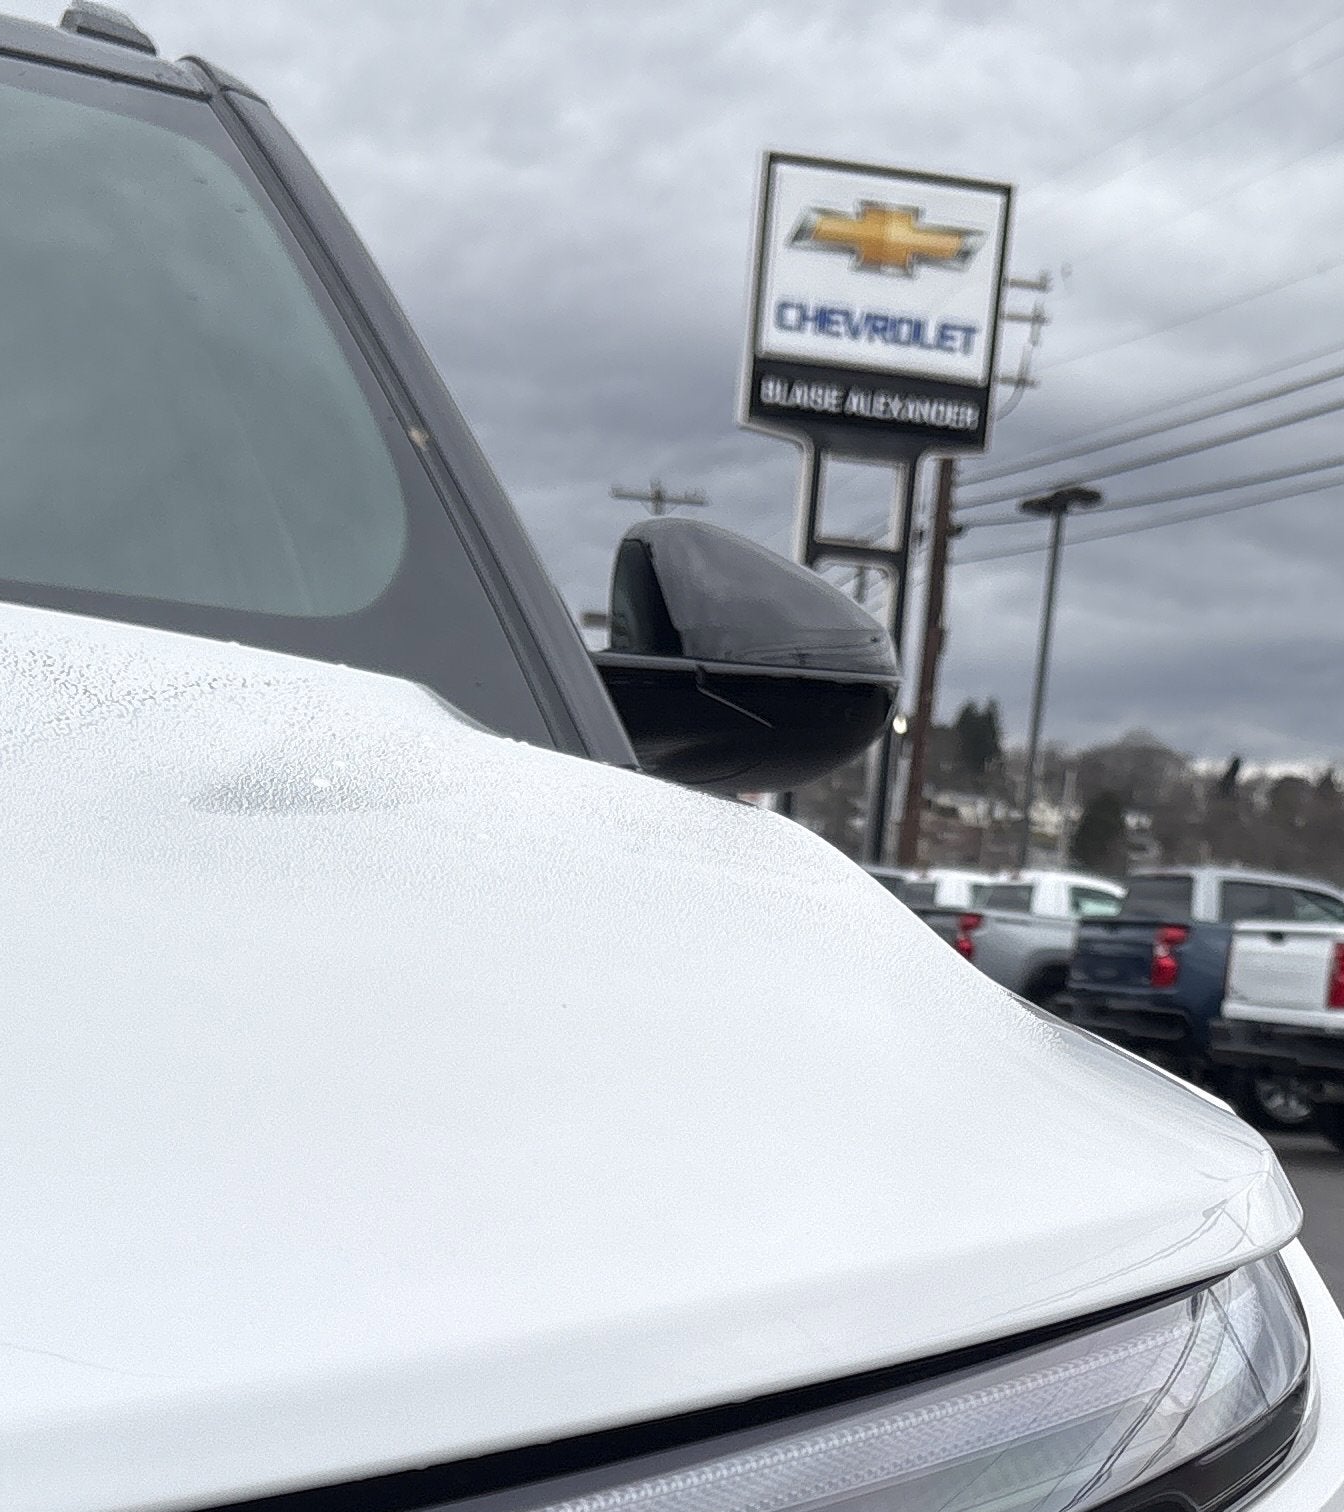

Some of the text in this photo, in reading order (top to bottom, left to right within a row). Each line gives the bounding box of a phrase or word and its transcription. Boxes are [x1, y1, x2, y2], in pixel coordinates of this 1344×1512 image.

[776, 301, 976, 353] CHEVROLET
[760, 375, 980, 430] BLAISE ALEXANDER
